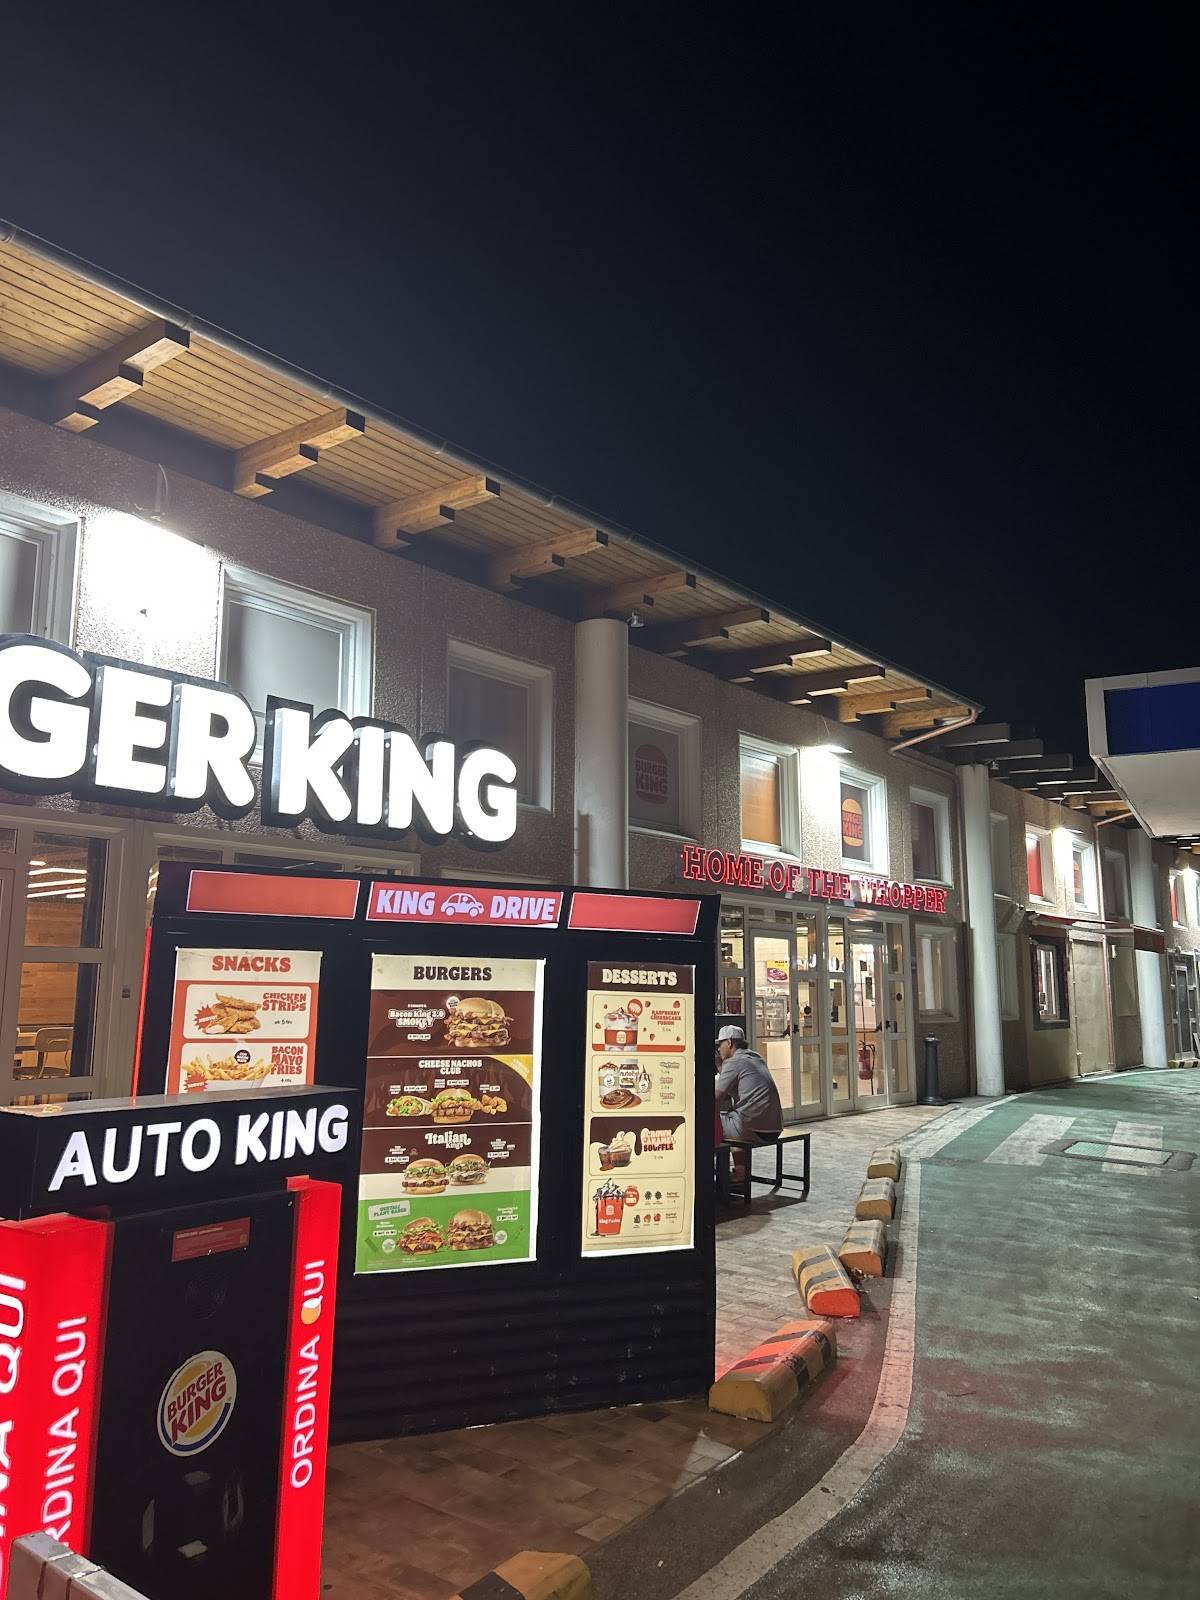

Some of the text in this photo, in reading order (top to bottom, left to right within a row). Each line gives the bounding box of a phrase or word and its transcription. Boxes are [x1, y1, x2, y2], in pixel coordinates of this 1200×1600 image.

[274, 707, 518, 843] KING
[683, 844, 948, 914] HOME OF THE WHOPPER
[376, 889, 556, 921] KING DRIVE
[211, 955, 291, 973] SNACKS
[413, 966, 492, 982] BURGERS
[602, 968, 678, 986] DESSERTS
[262, 992, 307, 1003] CHICKEN
[262, 1000, 307, 1012] STRIPS
[389, 1009, 413, 1018] Bacon
[413, 1009, 432, 1021] King
[397, 1018, 434, 1028] SMOKEY
[271, 1046, 304, 1055] BACON
[271, 1054, 304, 1066] MAYO
[418, 1059, 483, 1068] CHEESE NACHOS
[270, 1064, 303, 1075] FRIES
[440, 1067, 462, 1075] CLUB
[425, 1131, 472, 1146] Italian
[48, 1104, 349, 1192] AUTO KING
[373, 1209, 389, 1217] PLANT
[291, 1260, 325, 1489] ORDINA QUI
[168, 1362, 224, 1423] BURGER
[171, 1376, 227, 1446] KING
[42, 1315, 88, 1548] RDINA QUI
